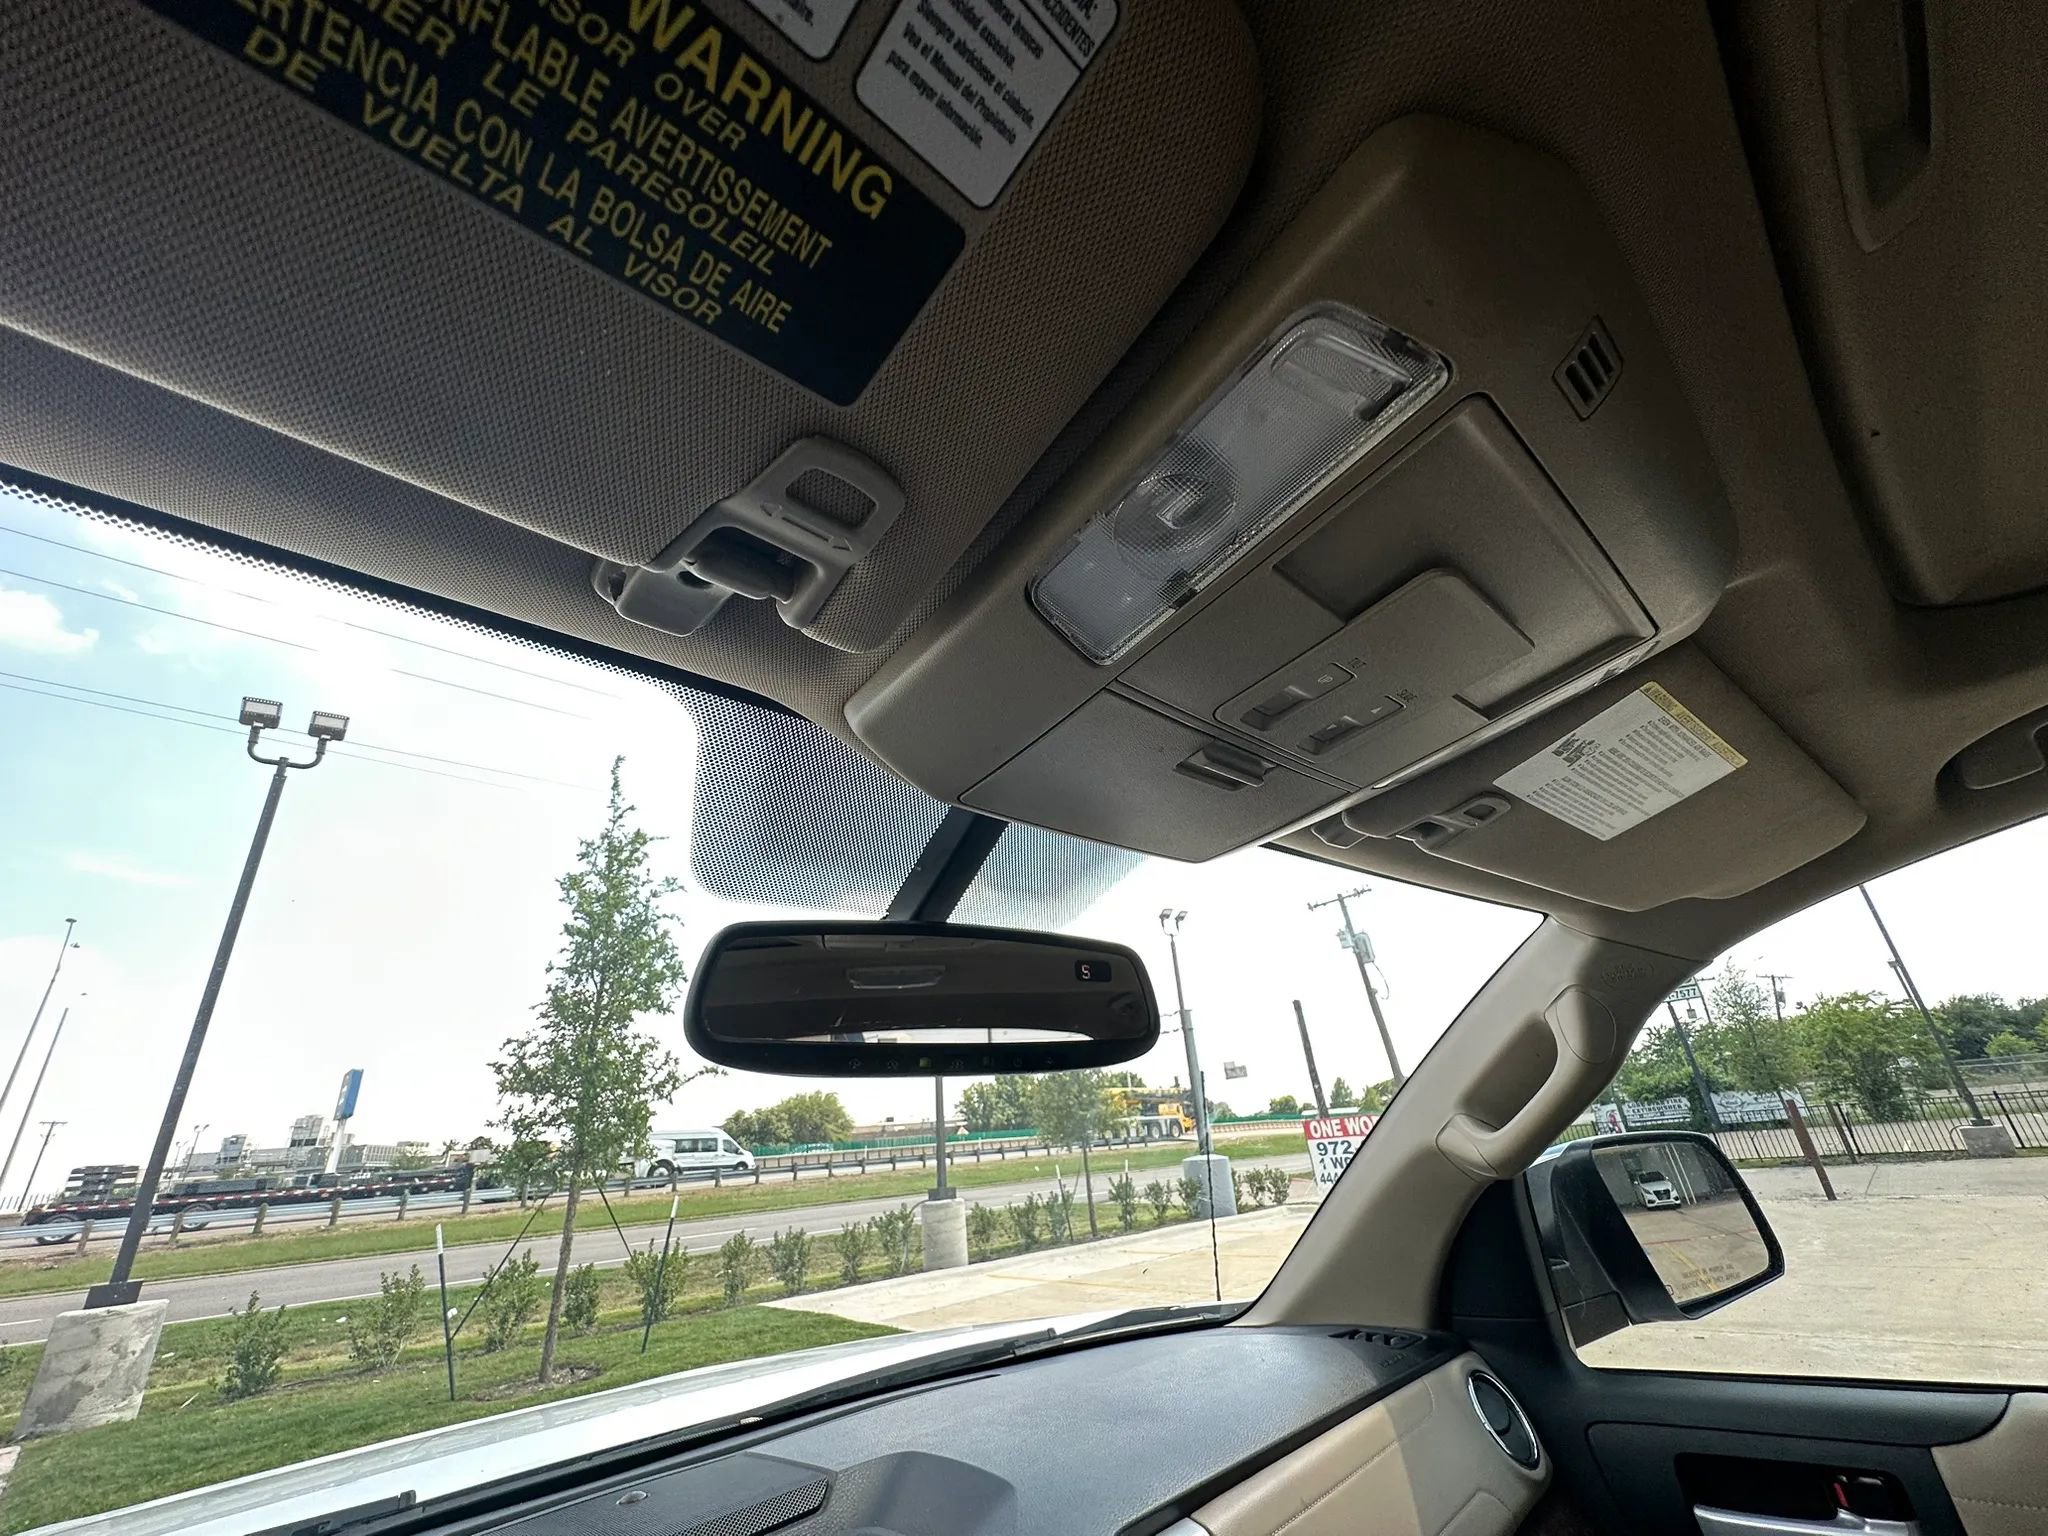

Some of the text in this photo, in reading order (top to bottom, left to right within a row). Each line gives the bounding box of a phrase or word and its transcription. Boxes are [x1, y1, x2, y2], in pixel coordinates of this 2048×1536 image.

[235, 0, 793, 332] RTENCIA CON LA BOLSA DE AIRE
[354, 0, 775, 276] ER LE PARESOLEIL
[538, 0, 748, 152] SOR OVER
[629, 0, 893, 221] WARNING
[242, 25, 722, 326] DE VUELTA AL VISOR
[609, 96, 833, 269] AVERTISSEMENT
[1668, 987, 1696, 1000] -7577
[1310, 1119, 1344, 1139] ONE
